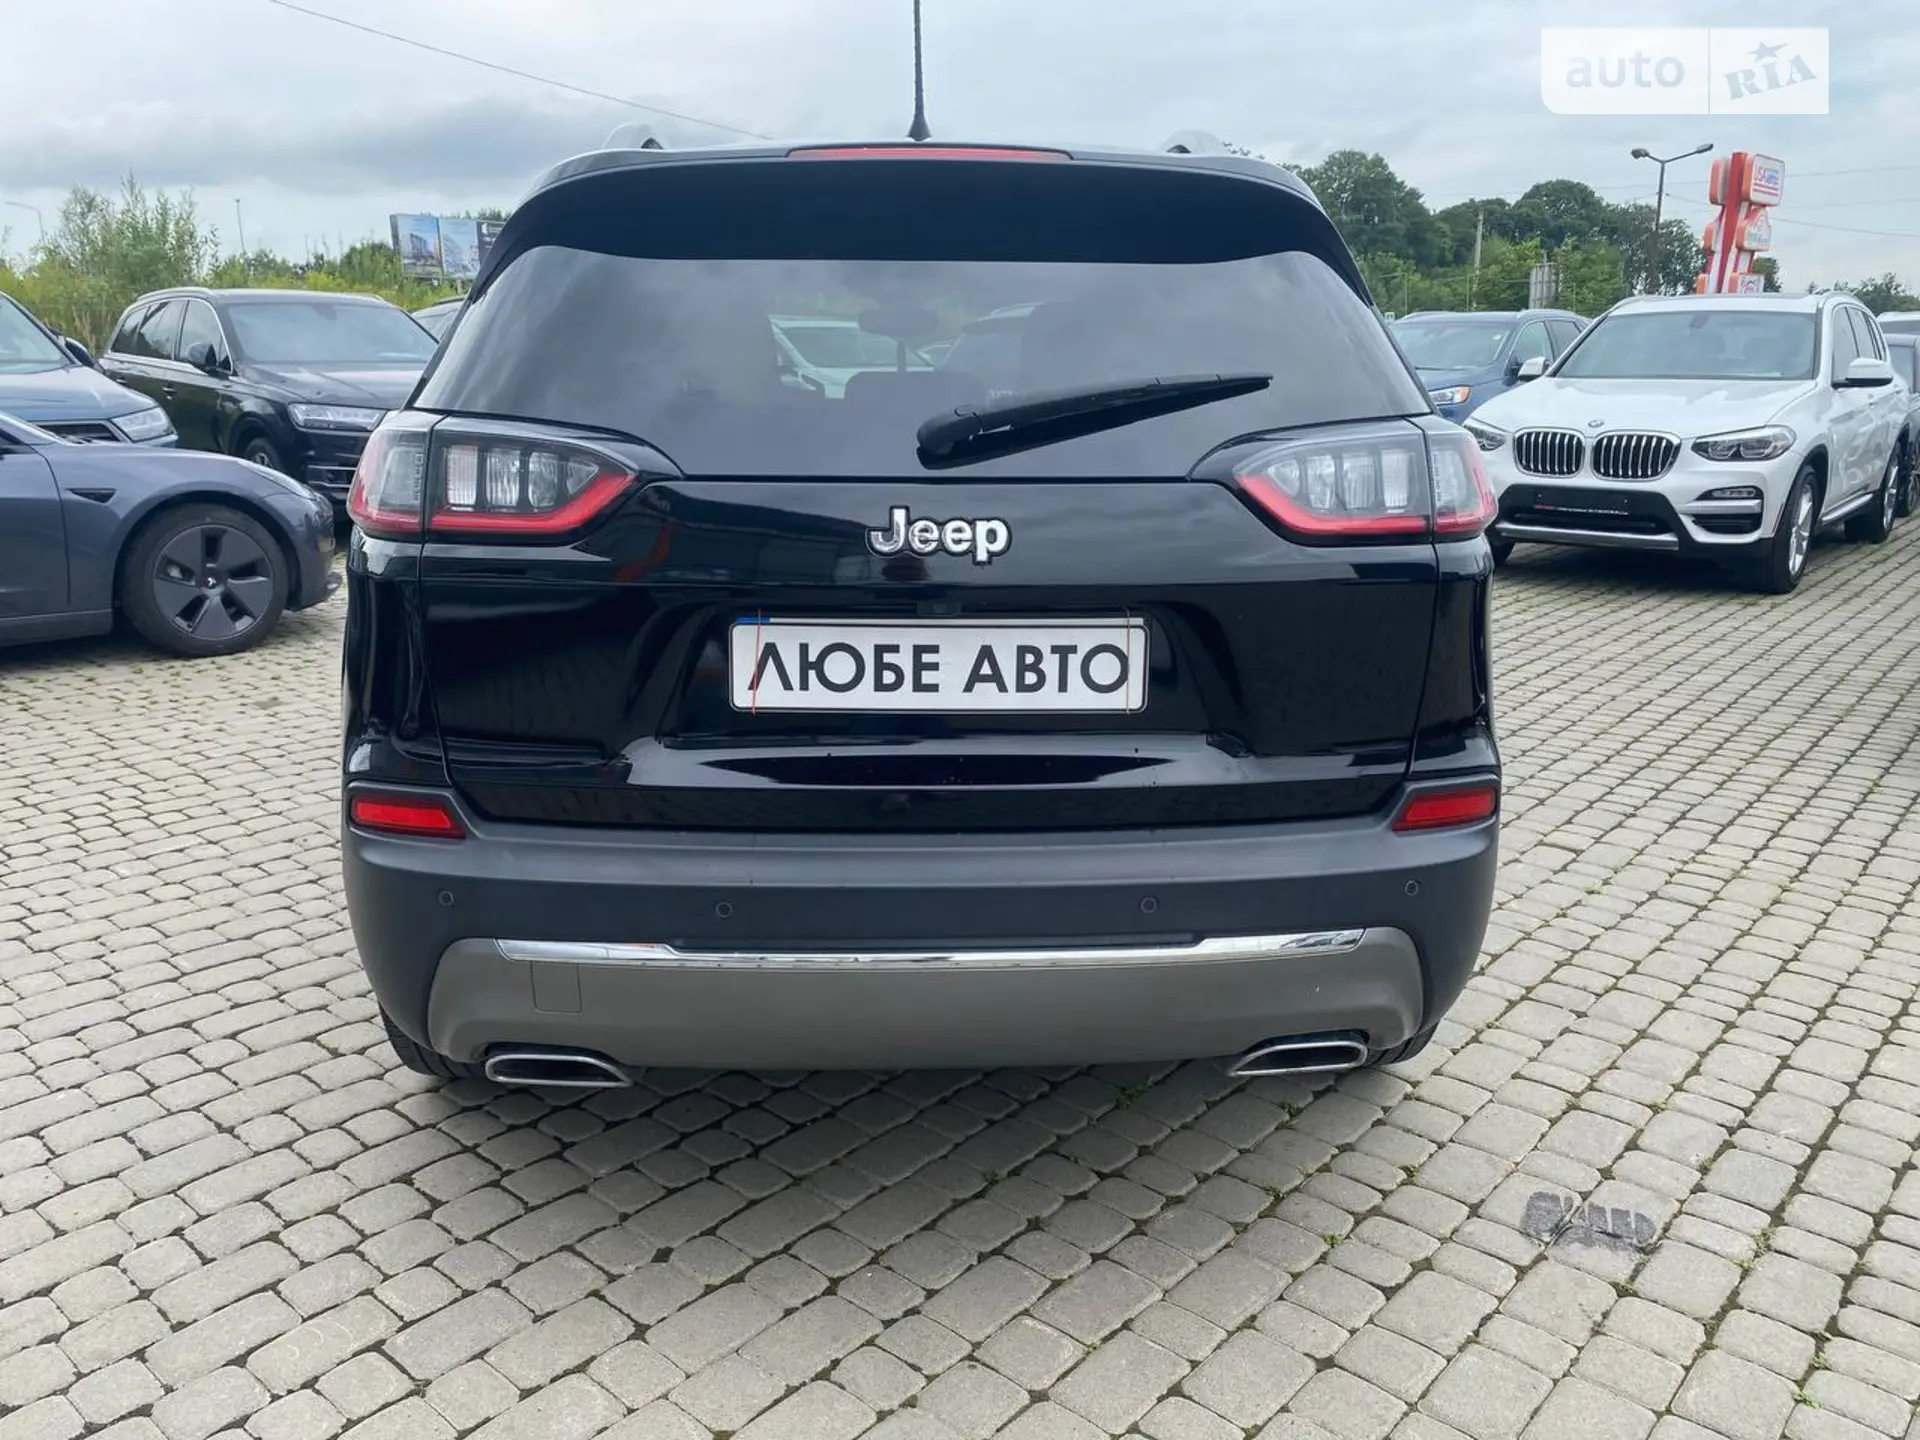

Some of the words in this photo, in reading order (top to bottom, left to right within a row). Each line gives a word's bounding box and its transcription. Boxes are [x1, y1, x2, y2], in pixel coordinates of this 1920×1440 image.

[867, 506, 1011, 564] Jeep
[748, 642, 940, 694] ЛЮБЕ
[962, 643, 1130, 694] АВТО
